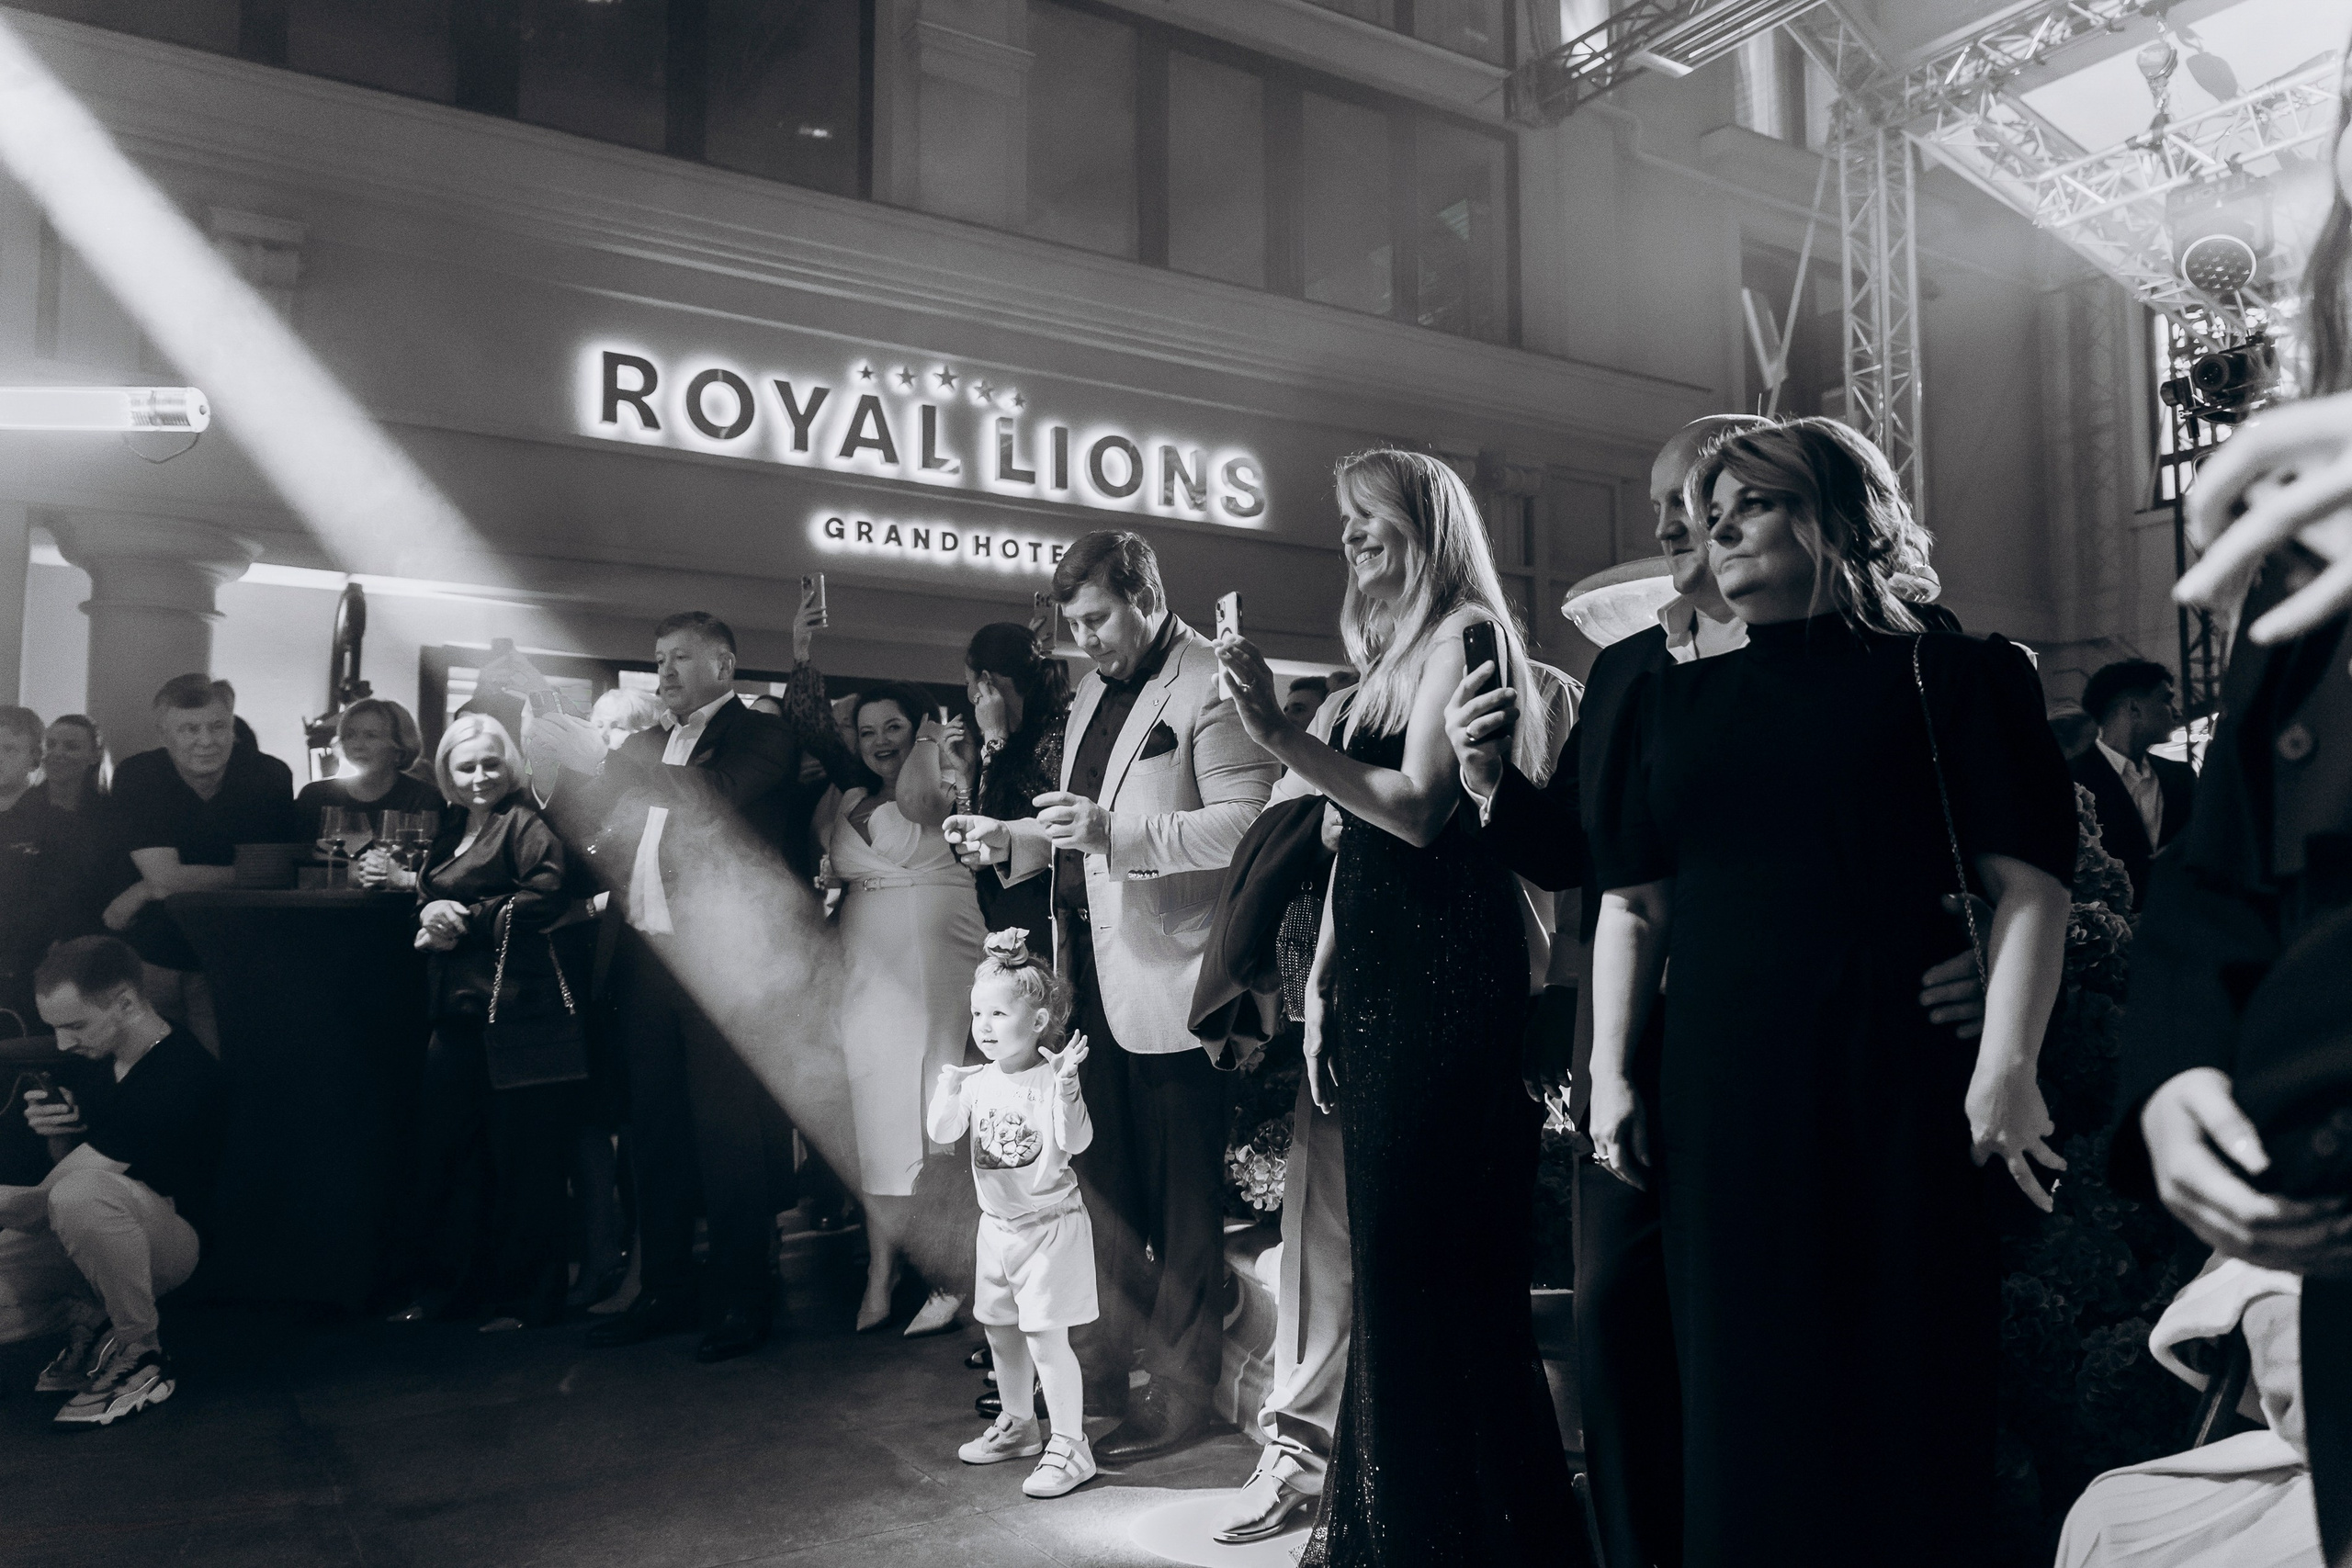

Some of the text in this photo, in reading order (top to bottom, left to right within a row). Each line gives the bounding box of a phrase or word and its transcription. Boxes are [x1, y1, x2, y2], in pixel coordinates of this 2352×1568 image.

[600, 351, 1265, 518] ROYAL LIONS
[824, 517, 1064, 565] GRAND HOTE
